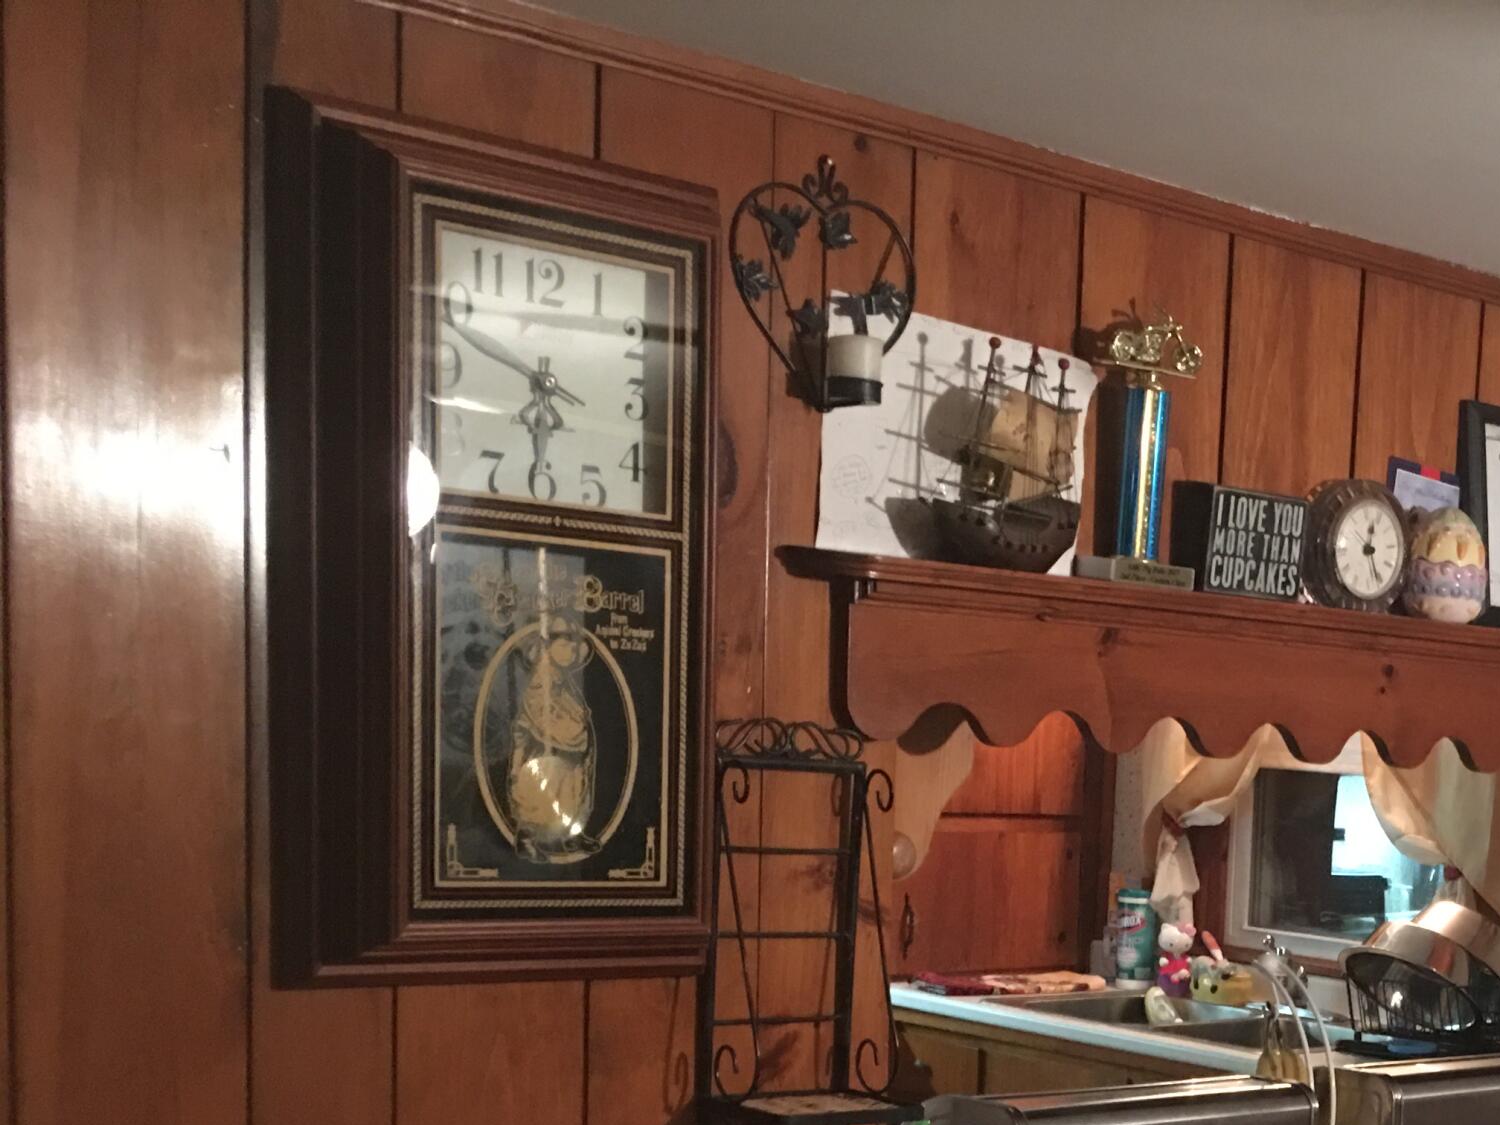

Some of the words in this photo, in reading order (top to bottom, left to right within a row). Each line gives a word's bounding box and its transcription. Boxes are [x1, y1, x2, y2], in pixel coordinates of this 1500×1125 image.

[471, 246, 504, 298] 11
[524, 257, 565, 308] 12
[593, 271, 603, 317] 1
[622, 315, 646, 362] 2
[624, 377, 649, 422] 3
[478, 449, 505, 494] 7
[527, 460, 557, 501] 6
[618, 441, 648, 483] 4
[579, 464, 608, 509] 5
[1217, 493, 1224, 527] I
[1228, 496, 1269, 533] LOVE
[1273, 501, 1305, 538] YOU
[1212, 527, 1258, 560] MORE
[1263, 533, 1301, 566] THAN
[1209, 554, 1299, 597] CUPCAKES
